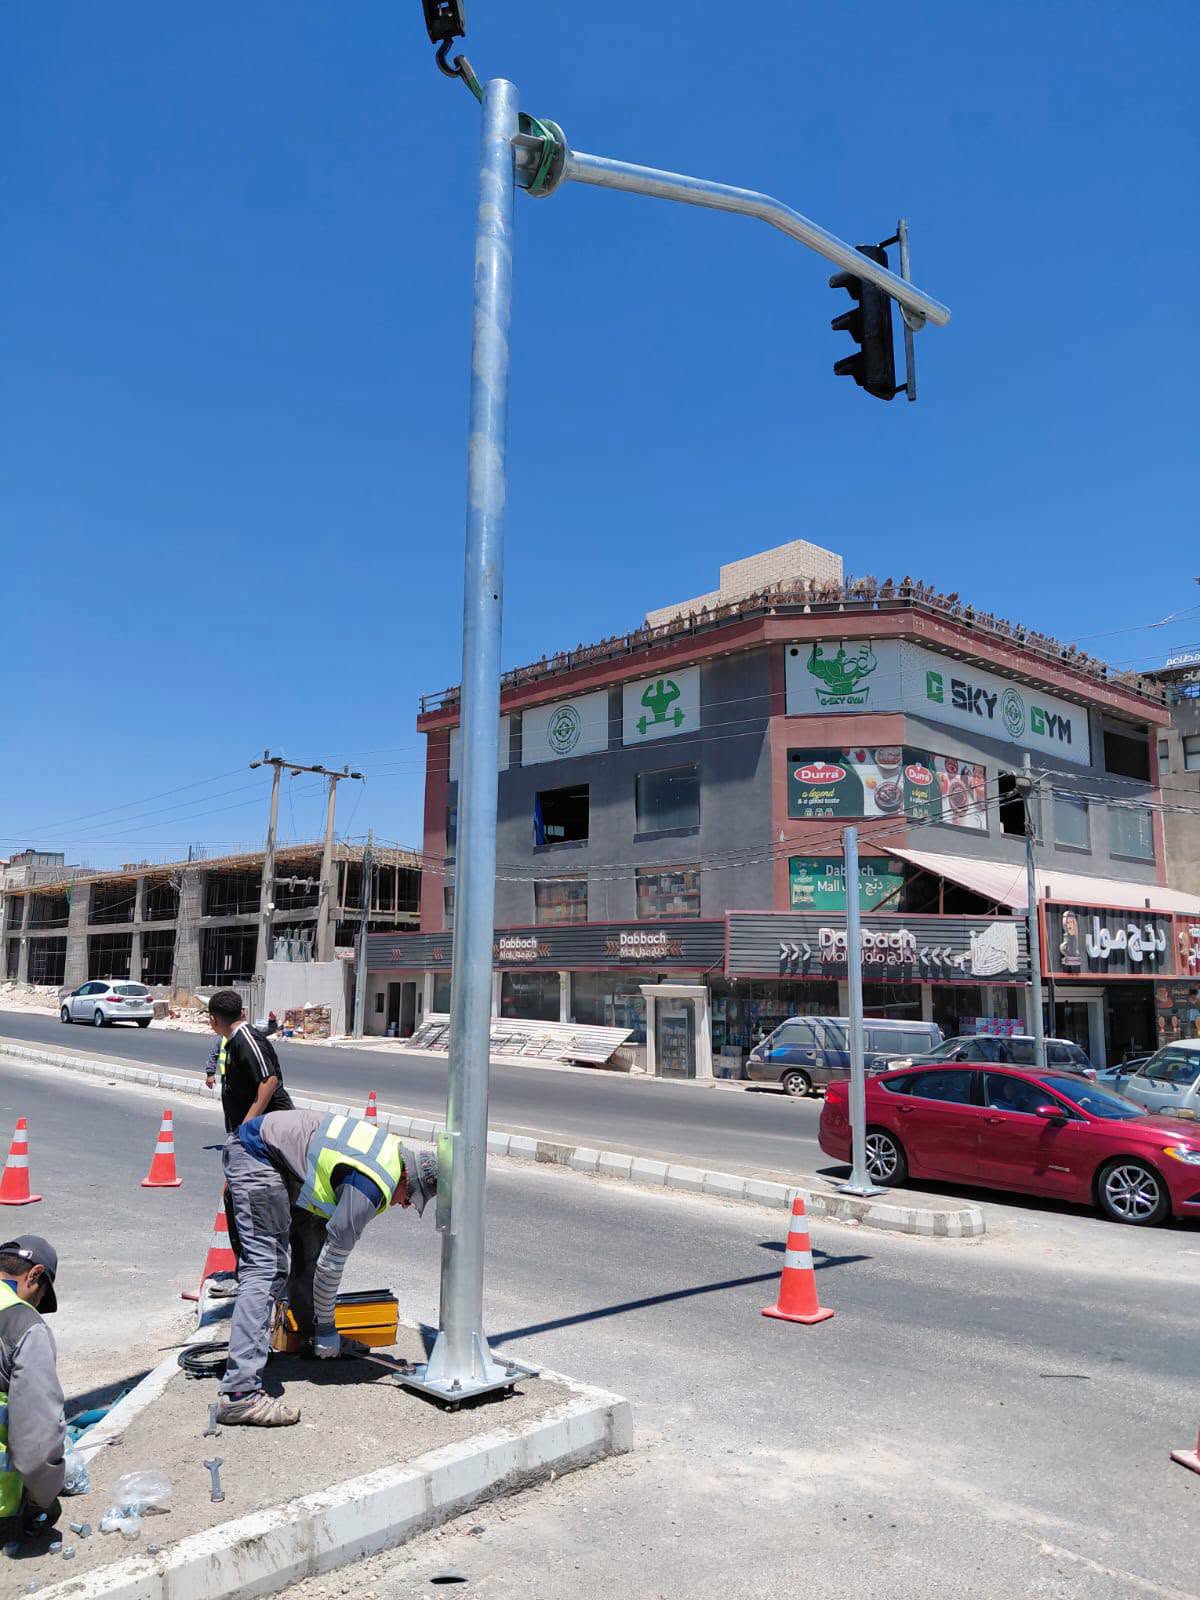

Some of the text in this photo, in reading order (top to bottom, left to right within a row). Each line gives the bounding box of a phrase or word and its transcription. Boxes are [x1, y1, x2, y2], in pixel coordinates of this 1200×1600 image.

[926, 671, 944, 704] G
[951, 678, 998, 719] SKY
[1030, 705, 1072, 745] GYM
[801, 770, 839, 779] Durra
[909, 769, 930, 782] Durra
[826, 865, 874, 876] Dabch
[817, 880, 840, 892] Mall
[499, 938, 537, 949] Dabbach
[620, 933, 666, 945] Dabbach
[818, 928, 917, 948] Dabach
[1085, 916, 1127, 959] مول
[821, 951, 848, 962] Mal
